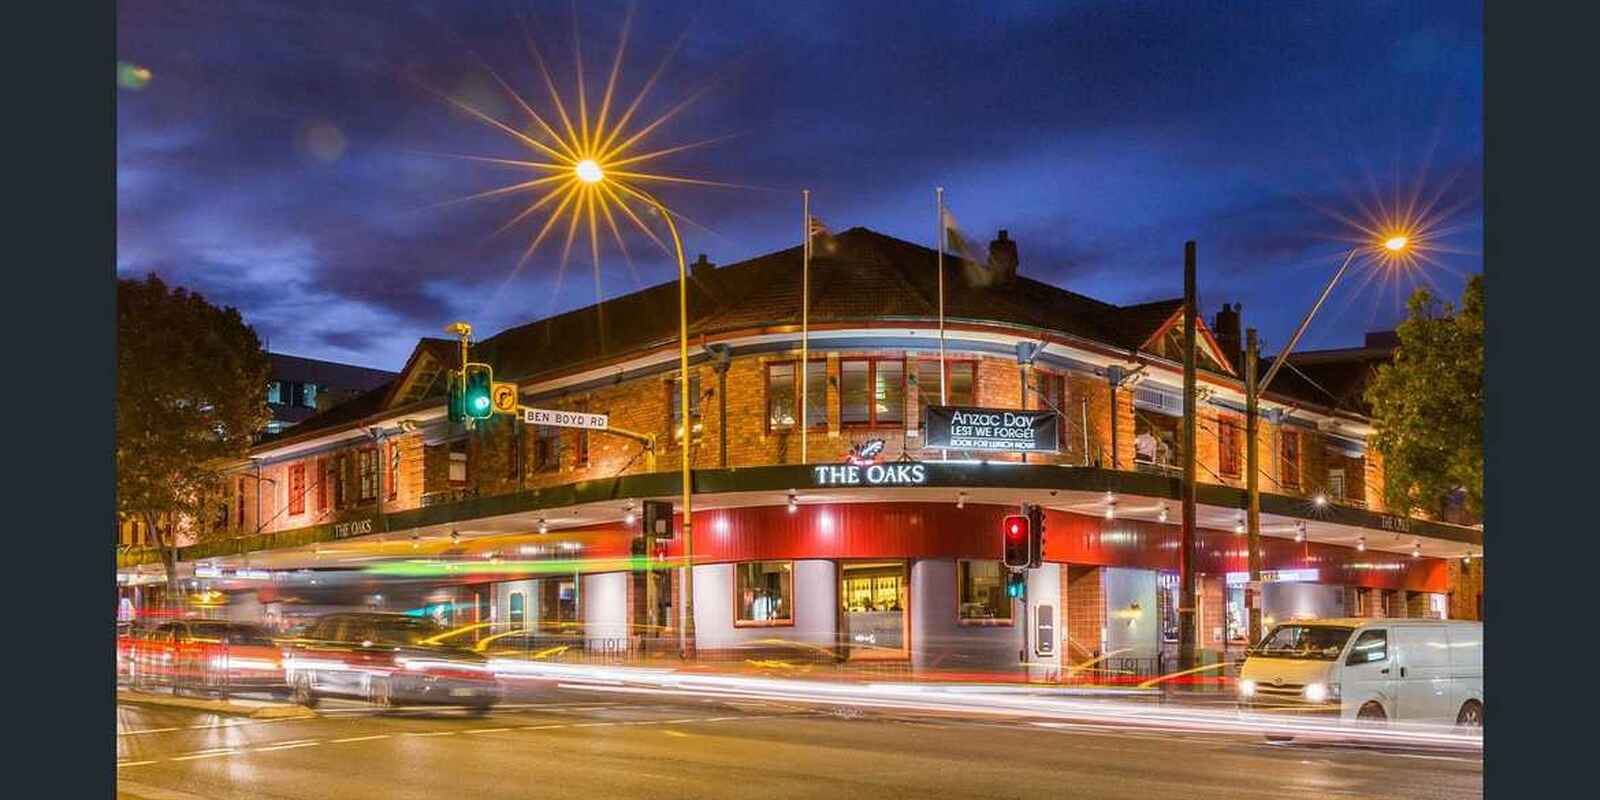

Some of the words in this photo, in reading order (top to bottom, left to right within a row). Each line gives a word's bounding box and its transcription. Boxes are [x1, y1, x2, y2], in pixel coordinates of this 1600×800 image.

[527, 411, 550, 422] BEN
[555, 414, 585, 425] BOYD
[590, 416, 605, 427] RD
[951, 411, 1001, 426] Anzac
[1004, 413, 1035, 428] Day
[951, 425, 973, 436] LEST
[975, 426, 993, 437] WE
[994, 427, 1035, 438] FORGET
[950, 439, 973, 447] BOOK
[815, 465, 860, 484] THE
[866, 465, 926, 484] OAKS
